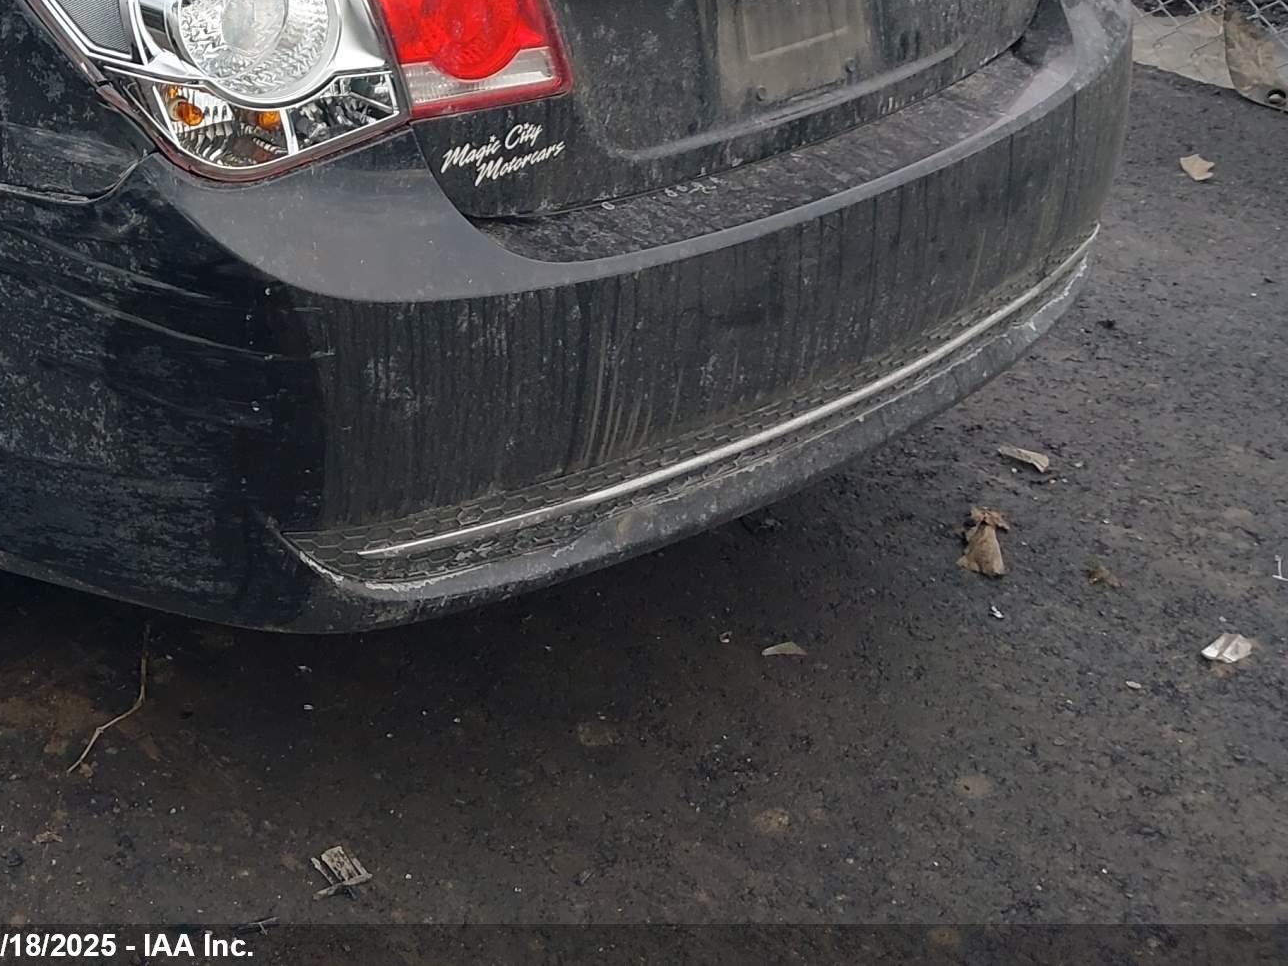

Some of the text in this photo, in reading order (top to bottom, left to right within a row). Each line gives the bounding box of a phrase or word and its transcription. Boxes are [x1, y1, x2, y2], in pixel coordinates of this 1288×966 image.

[441, 122, 543, 174] Magic City
[474, 141, 566, 187] Motorcars
